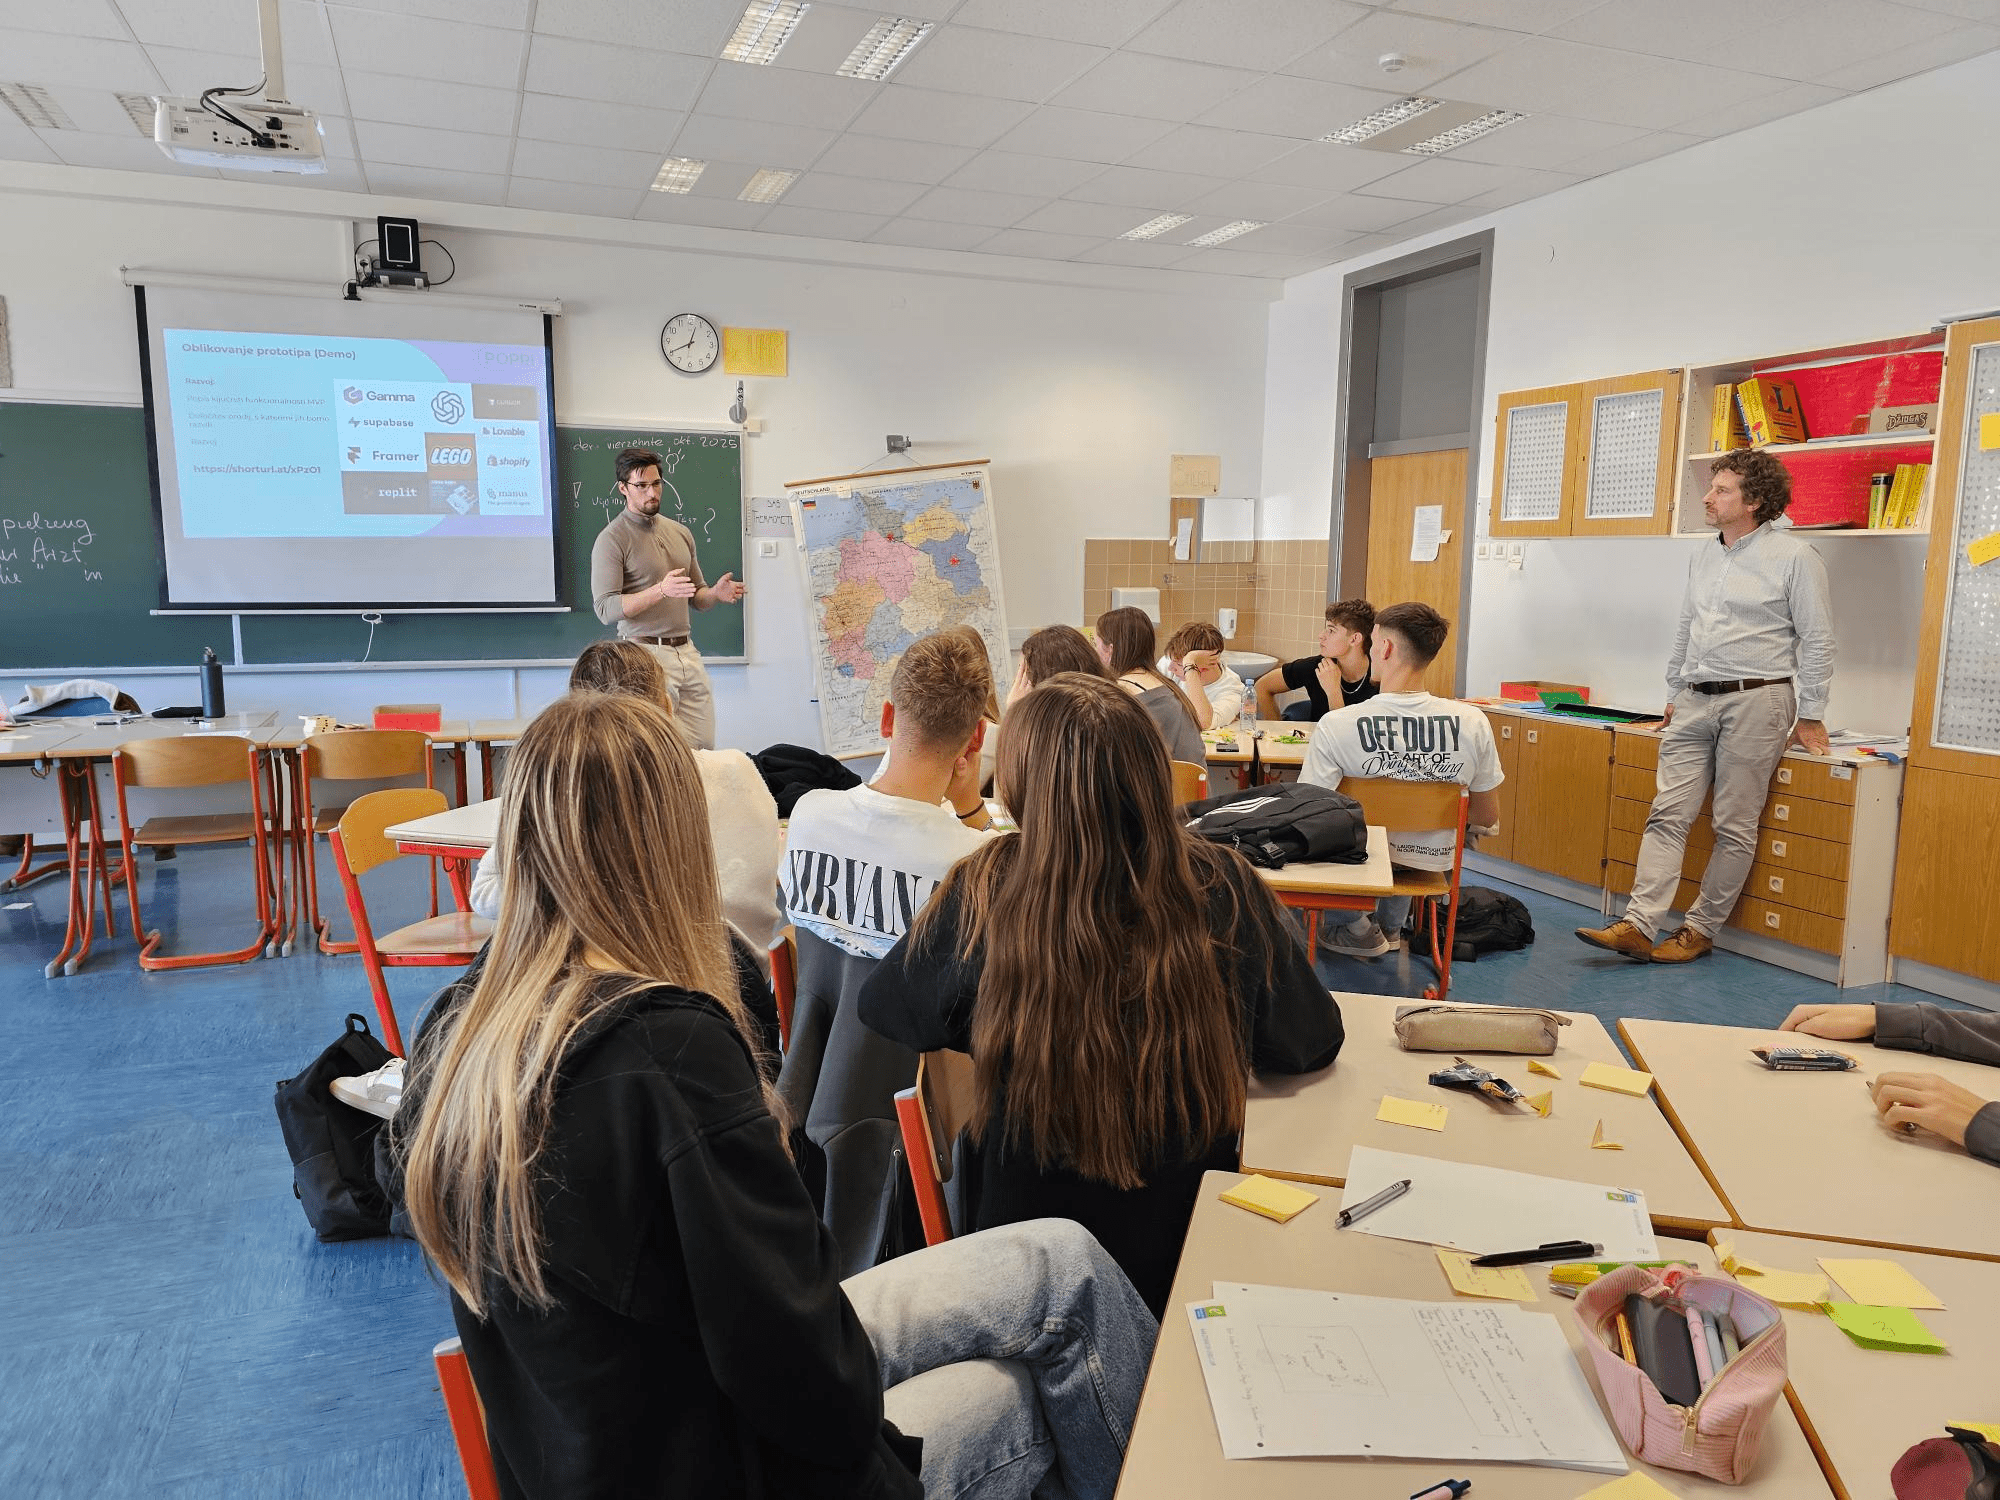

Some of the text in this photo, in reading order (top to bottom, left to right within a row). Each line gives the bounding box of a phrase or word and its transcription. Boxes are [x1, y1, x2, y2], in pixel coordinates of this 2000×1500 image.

[182, 343, 356, 360] Oblikovanje prototipa (Demo)
[366, 390, 416, 402] Gamma
[1772, 385, 1793, 414] L
[363, 418, 414, 429] supabase
[492, 426, 526, 436] Lovable
[606, 436, 664, 450] vierzehnte
[700, 437, 738, 449] 2025
[372, 450, 420, 462] Framer
[430, 446, 473, 466] LEGO
[499, 456, 531, 468] shopify
[378, 487, 418, 499] replit
[1356, 715, 1460, 753] OFF DUTY
[1431, 753, 1451, 763] OF
